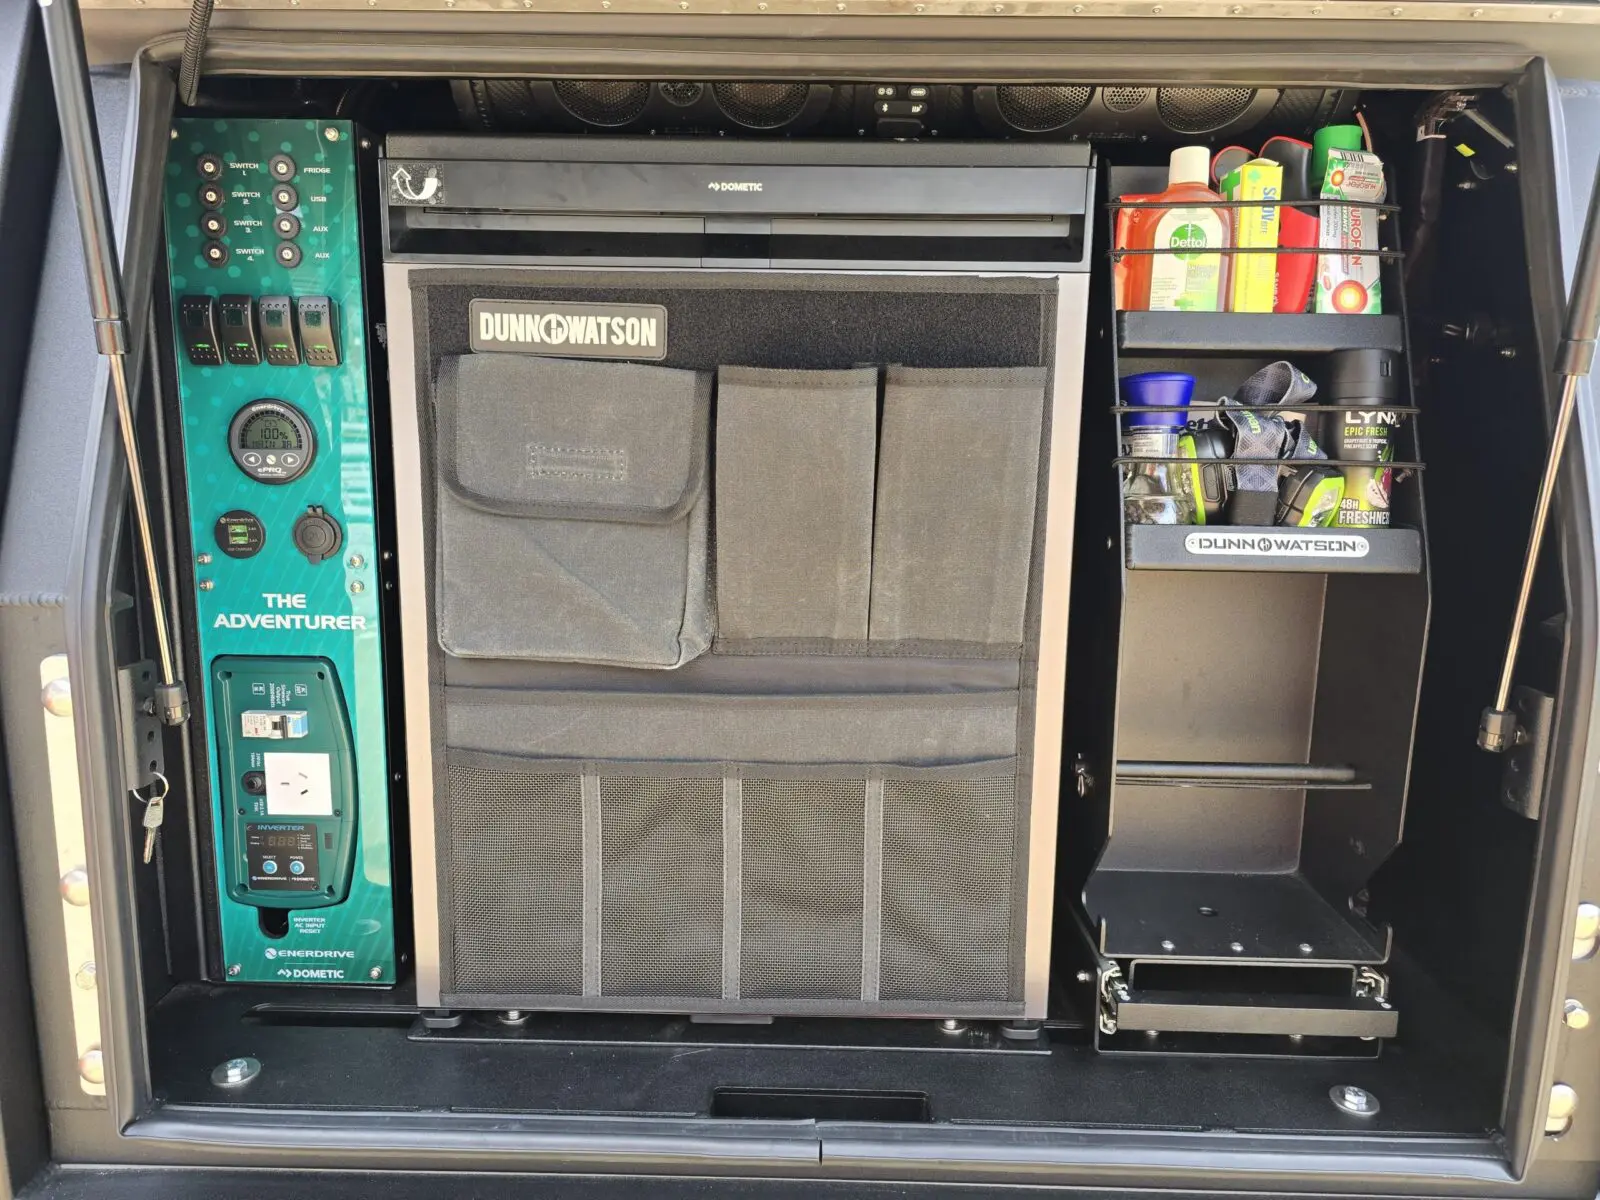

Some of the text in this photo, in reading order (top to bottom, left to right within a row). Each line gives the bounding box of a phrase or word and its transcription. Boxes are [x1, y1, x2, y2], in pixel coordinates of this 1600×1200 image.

[720, 182, 762, 191] DOMETIC
[1170, 236, 1207, 248] Dettol
[565, 316, 657, 347] WATSON
[1346, 411, 1397, 424] LYNX
[1344, 427, 1388, 436] EPIC FRESH
[1340, 499, 1359, 510] 48H
[1199, 538, 1357, 552] DUNN WATSON
[262, 593, 307, 608] THE
[214, 613, 367, 630] ADVENTURER
[278, 950, 355, 958] ENERDRIVE
[294, 970, 344, 978] DOMETIC
